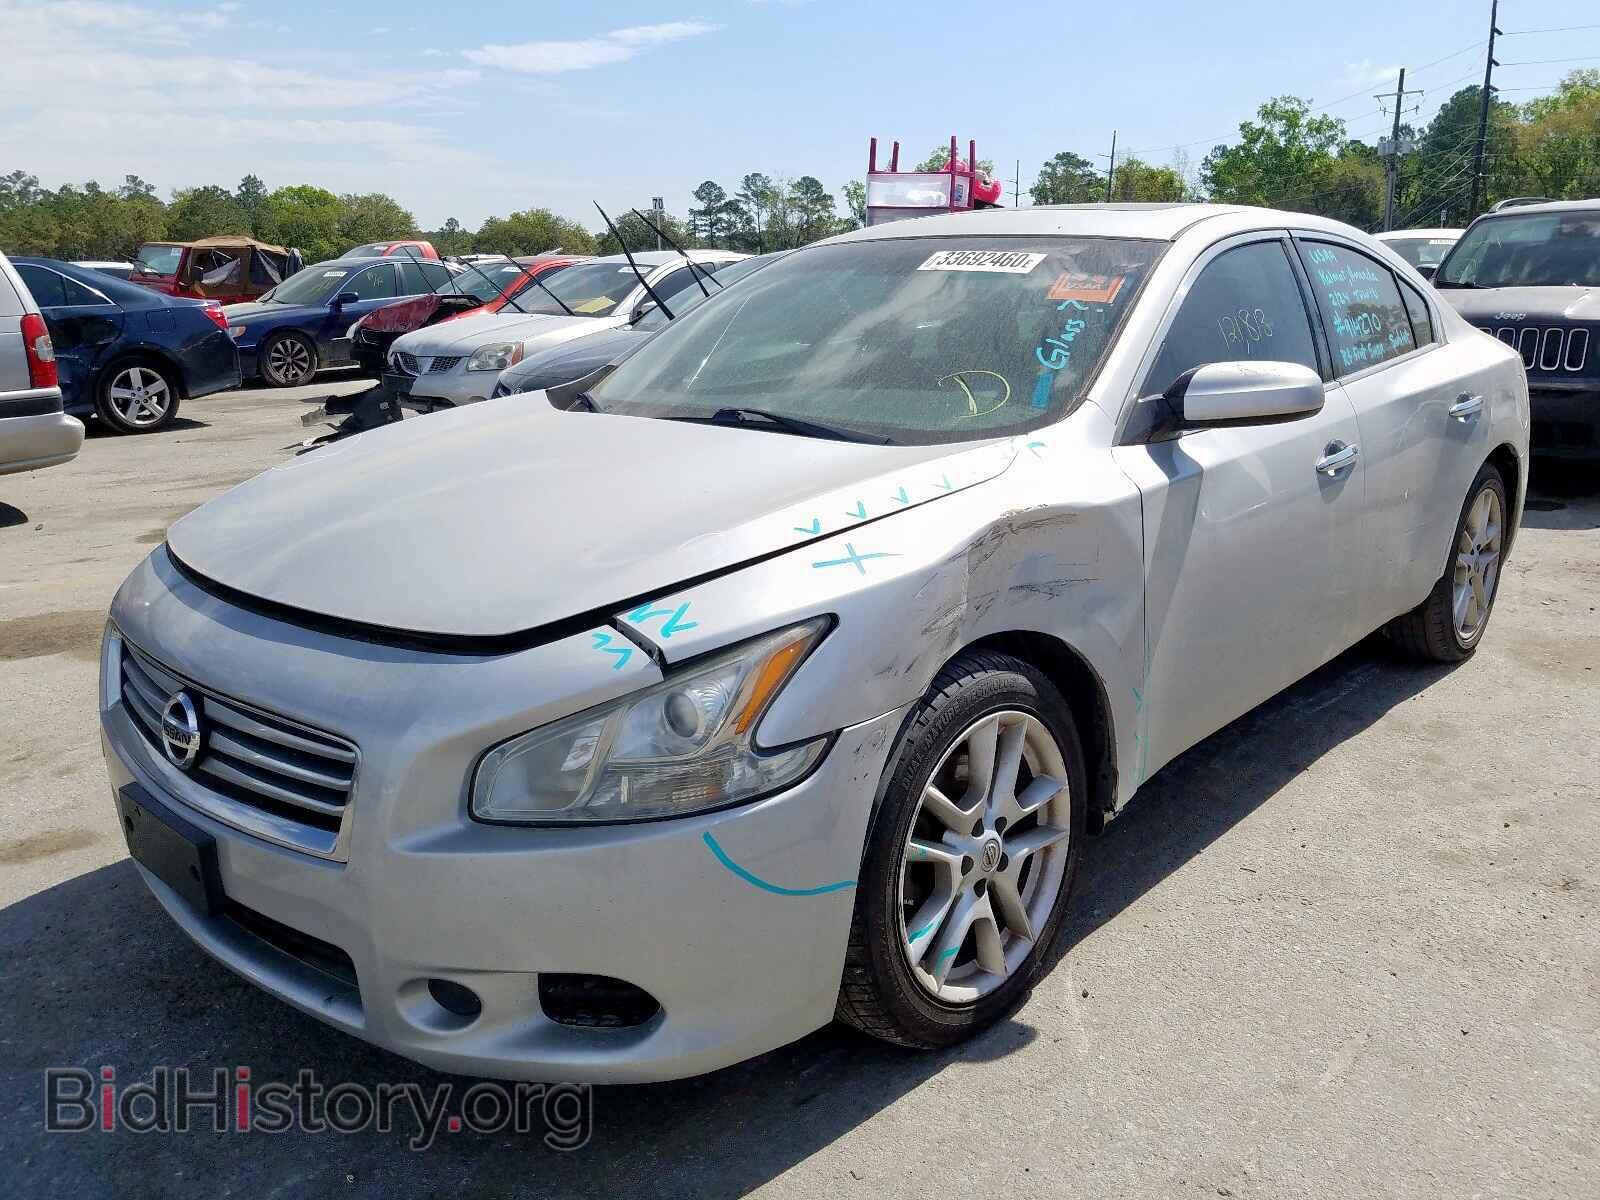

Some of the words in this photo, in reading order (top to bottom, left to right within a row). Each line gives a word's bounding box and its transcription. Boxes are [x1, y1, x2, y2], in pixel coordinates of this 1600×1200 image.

[652, 198, 664, 210] 70
[936, 251, 1030, 268] 33692460
[1494, 310, 1527, 322] Jeep
